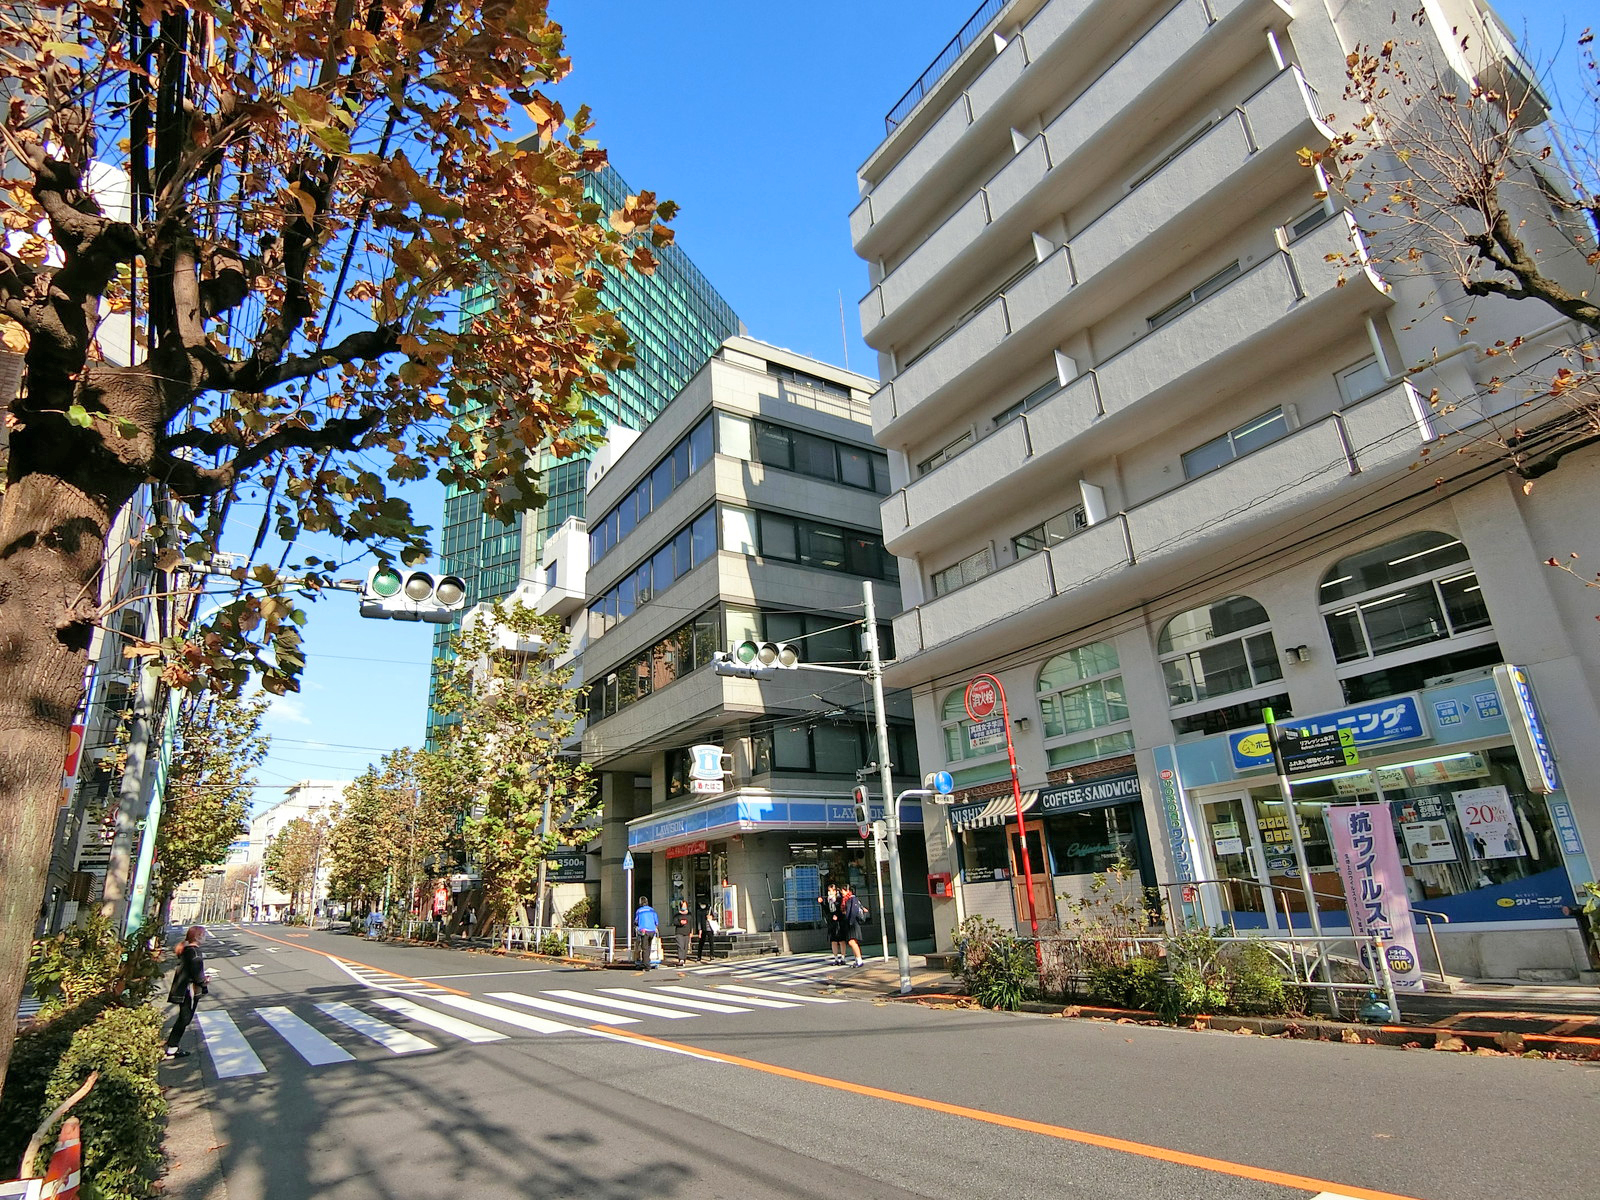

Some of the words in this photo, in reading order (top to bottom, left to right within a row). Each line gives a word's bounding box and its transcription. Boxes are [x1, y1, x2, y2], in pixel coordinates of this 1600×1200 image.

[972, 689, 994, 707] 消火栓
[1384, 728, 1400, 736] SINCE
[832, 807, 885, 819] LAON
[655, 820, 684, 837] LAWSON
[1515, 896, 1562, 906] クリーニング
